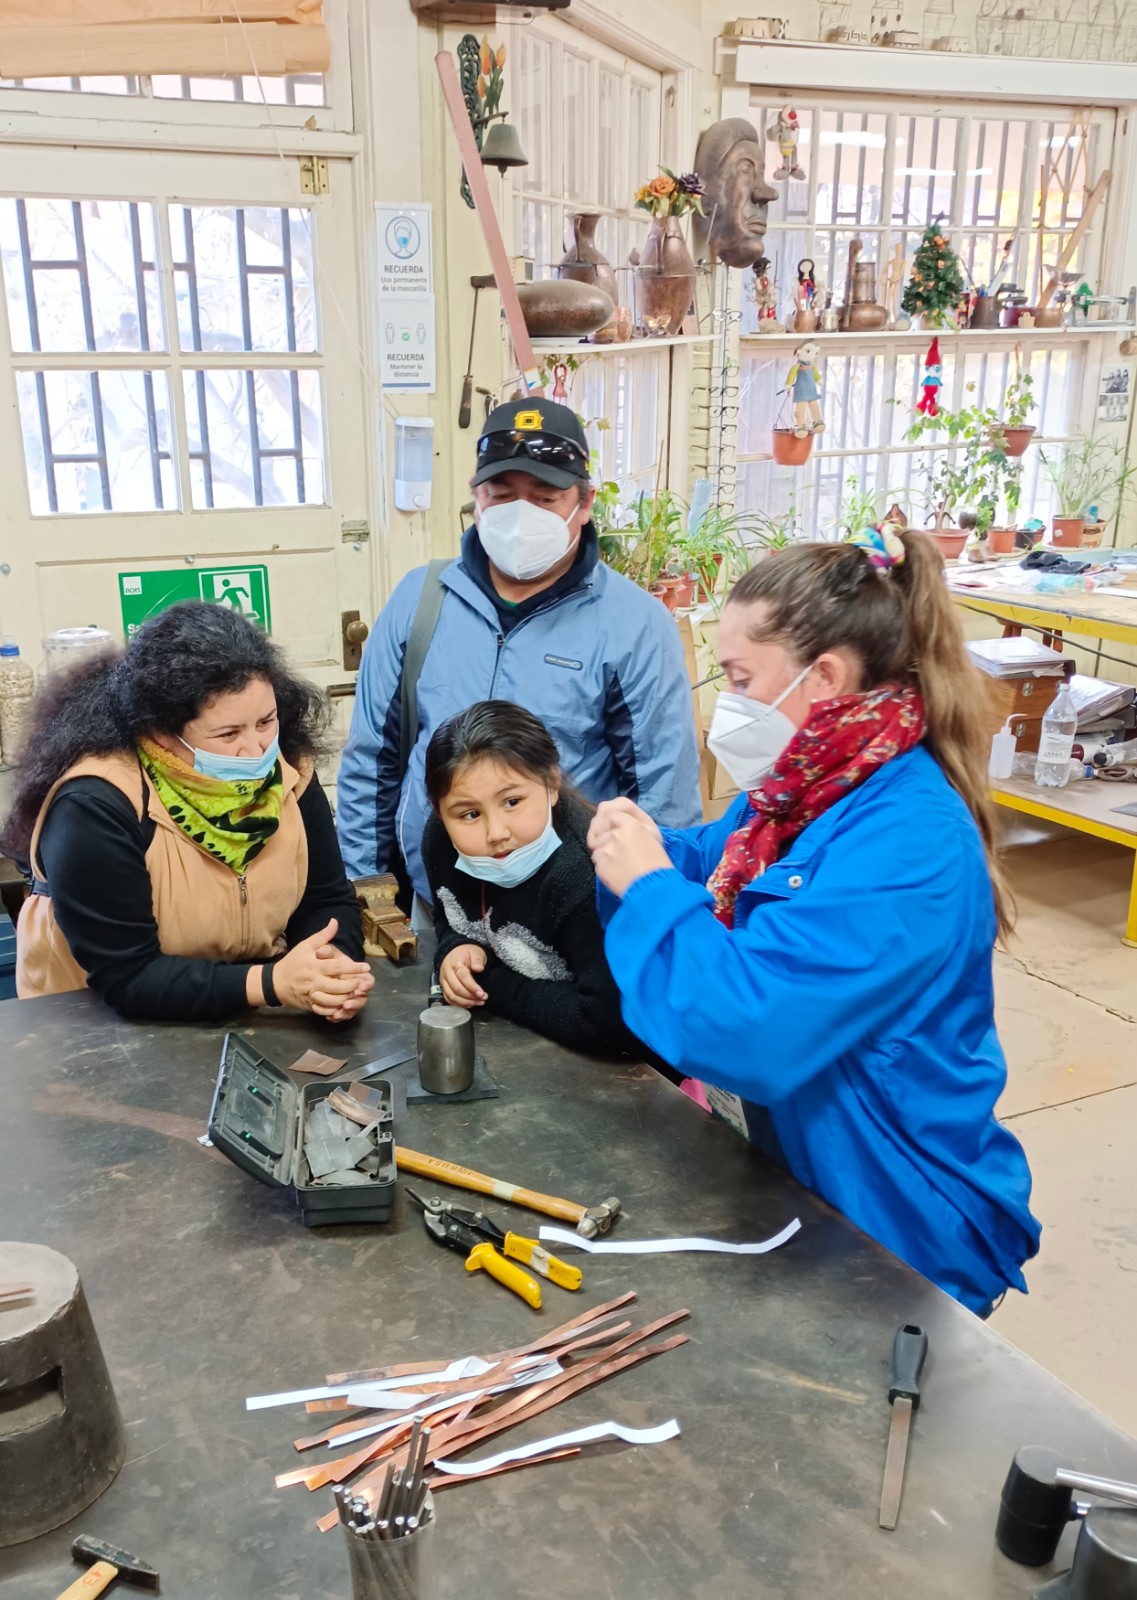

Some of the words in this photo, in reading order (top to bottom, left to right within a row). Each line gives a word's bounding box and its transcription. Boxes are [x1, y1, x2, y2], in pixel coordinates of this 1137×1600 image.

[384, 264, 424, 274] RECUERDA
[380, 276, 392, 284] Uso
[393, 277, 428, 285] permanente
[387, 353, 425, 361] RECUERDA
